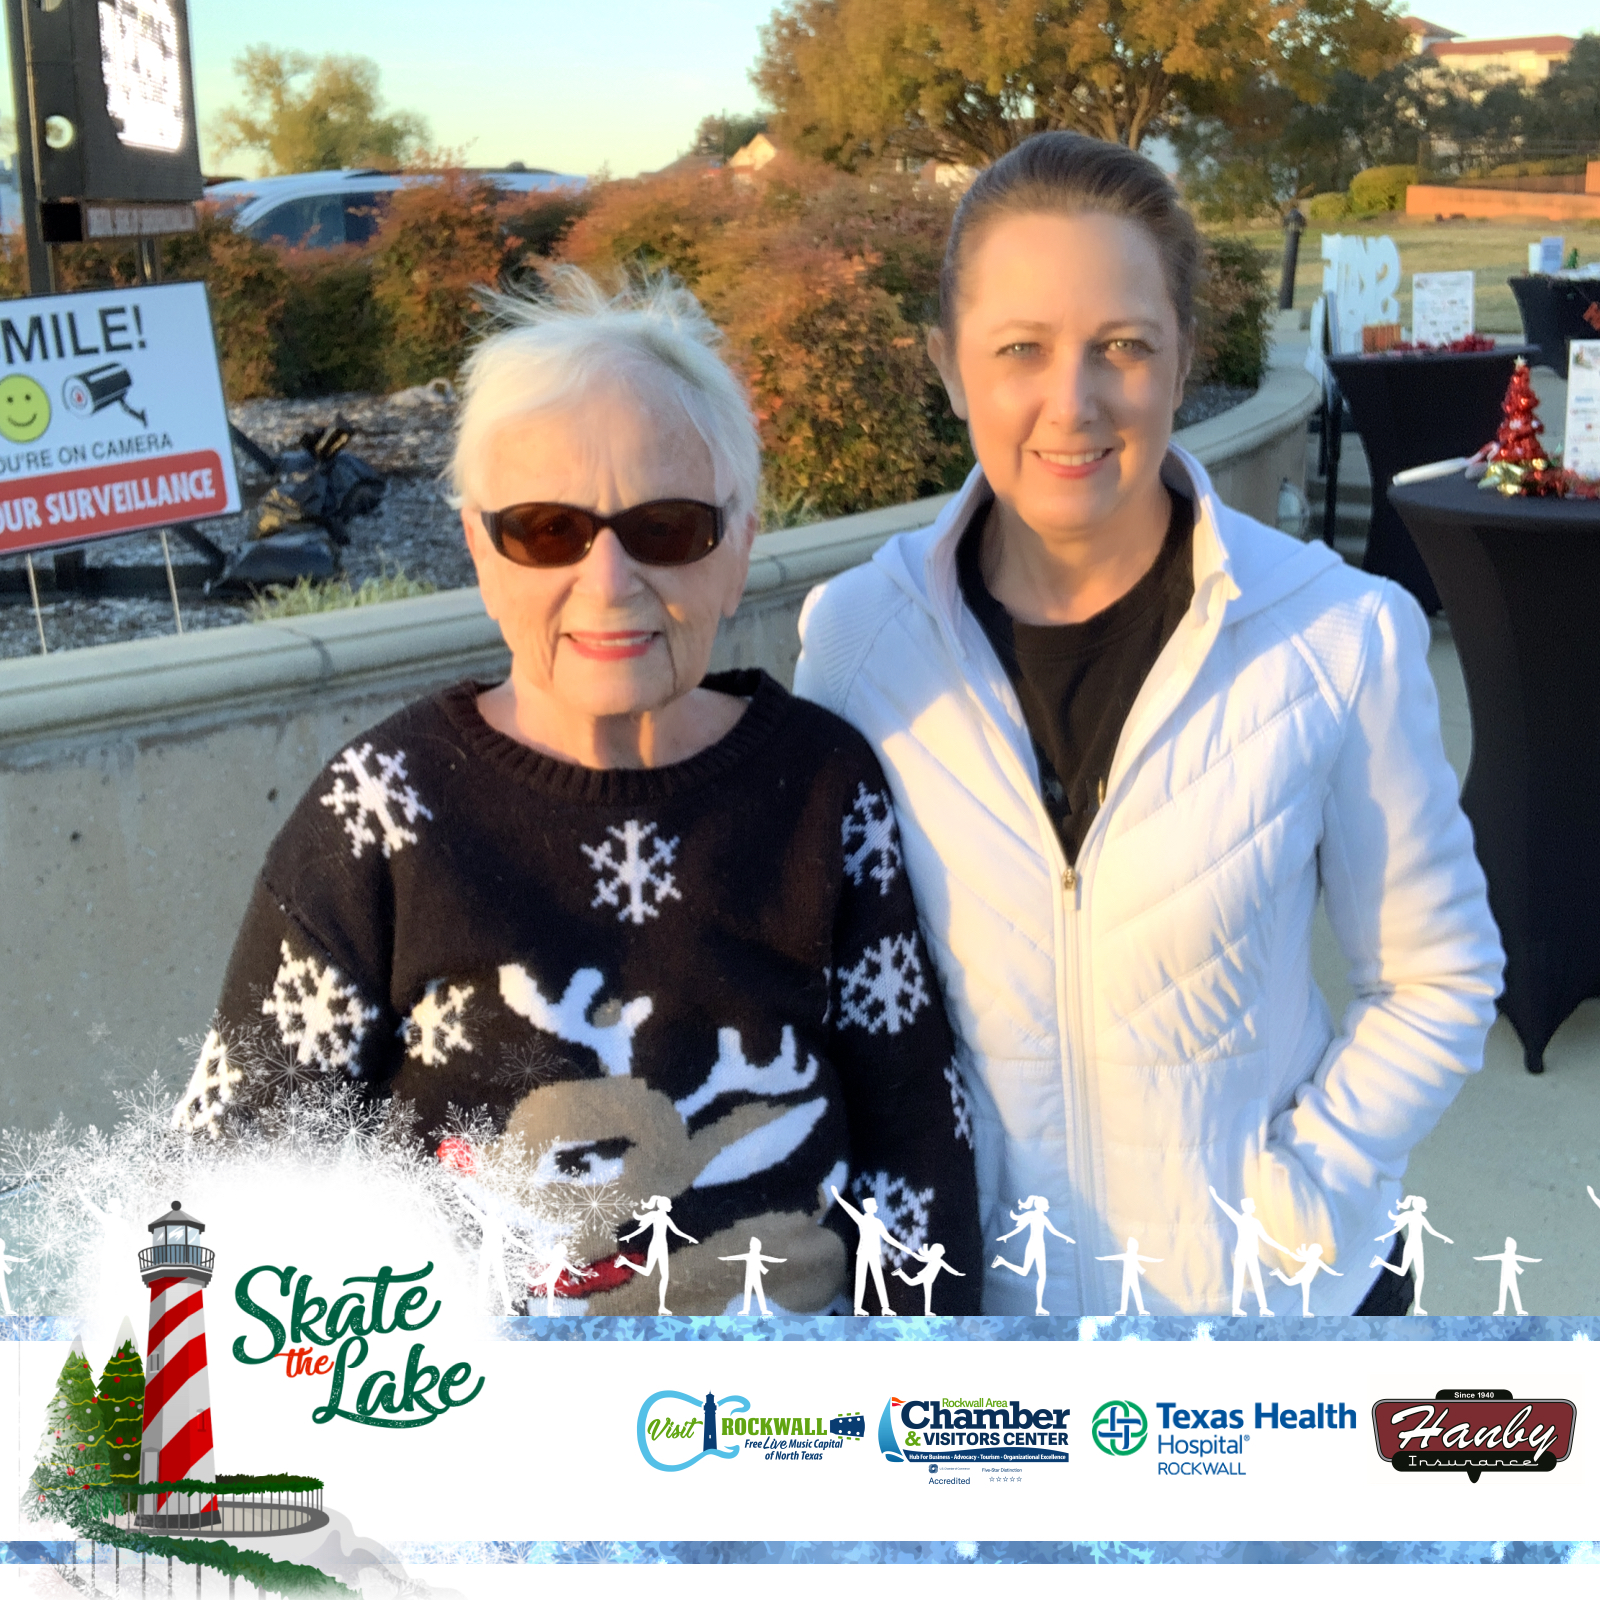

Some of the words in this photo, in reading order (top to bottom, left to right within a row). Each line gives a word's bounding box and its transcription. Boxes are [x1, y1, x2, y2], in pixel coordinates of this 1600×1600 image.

[0, 305, 147, 364] MILE!
[58, 445, 86, 466] ON
[92, 433, 173, 460] CAMERA
[0, 497, 42, 534] UR
[45, 468, 216, 525] SURVEILLANCE
